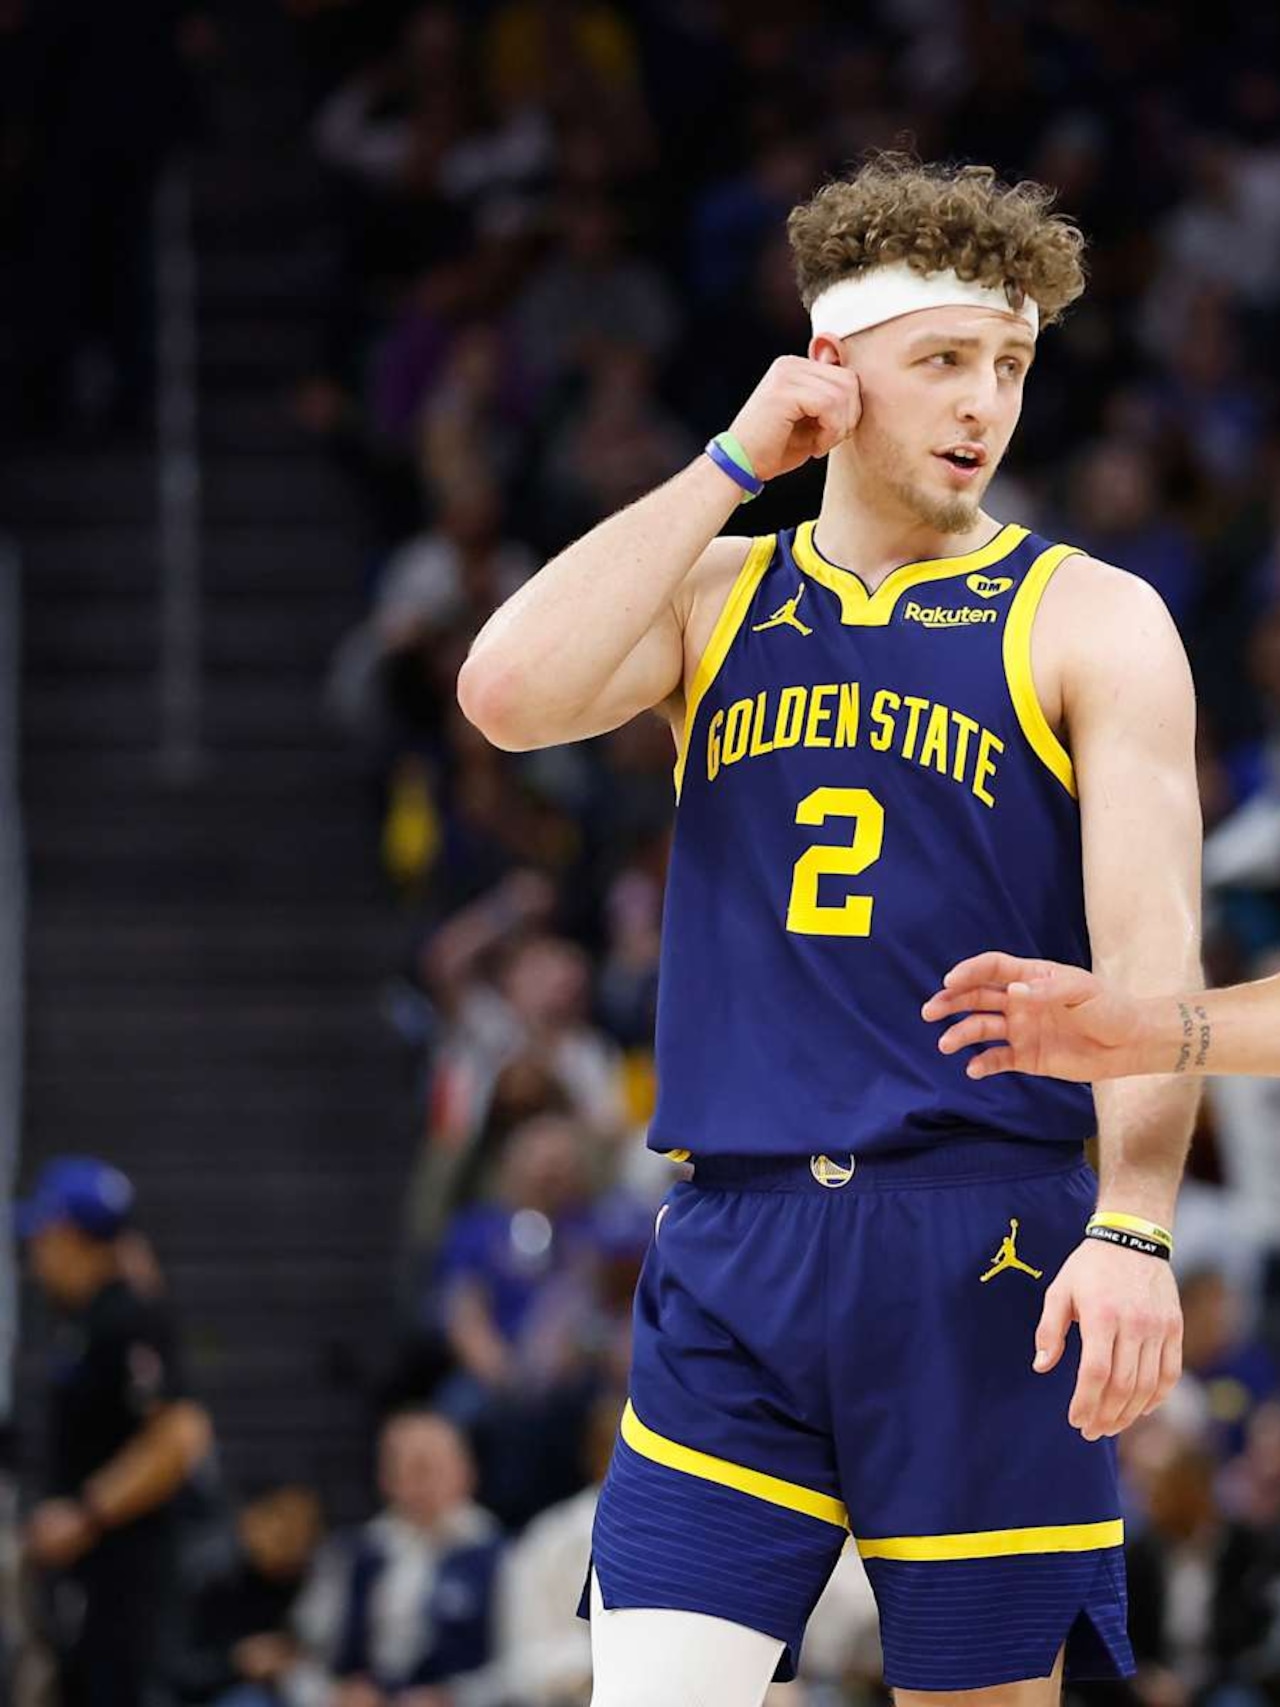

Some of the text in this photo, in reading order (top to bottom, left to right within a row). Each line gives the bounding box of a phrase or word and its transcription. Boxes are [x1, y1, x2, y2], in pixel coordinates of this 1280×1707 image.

[904, 601, 997, 628] Rakuten
[707, 682, 1005, 808] GOLDEN STATE
[785, 786, 885, 937] 2
[1129, 1238, 1158, 1252] PLAY
